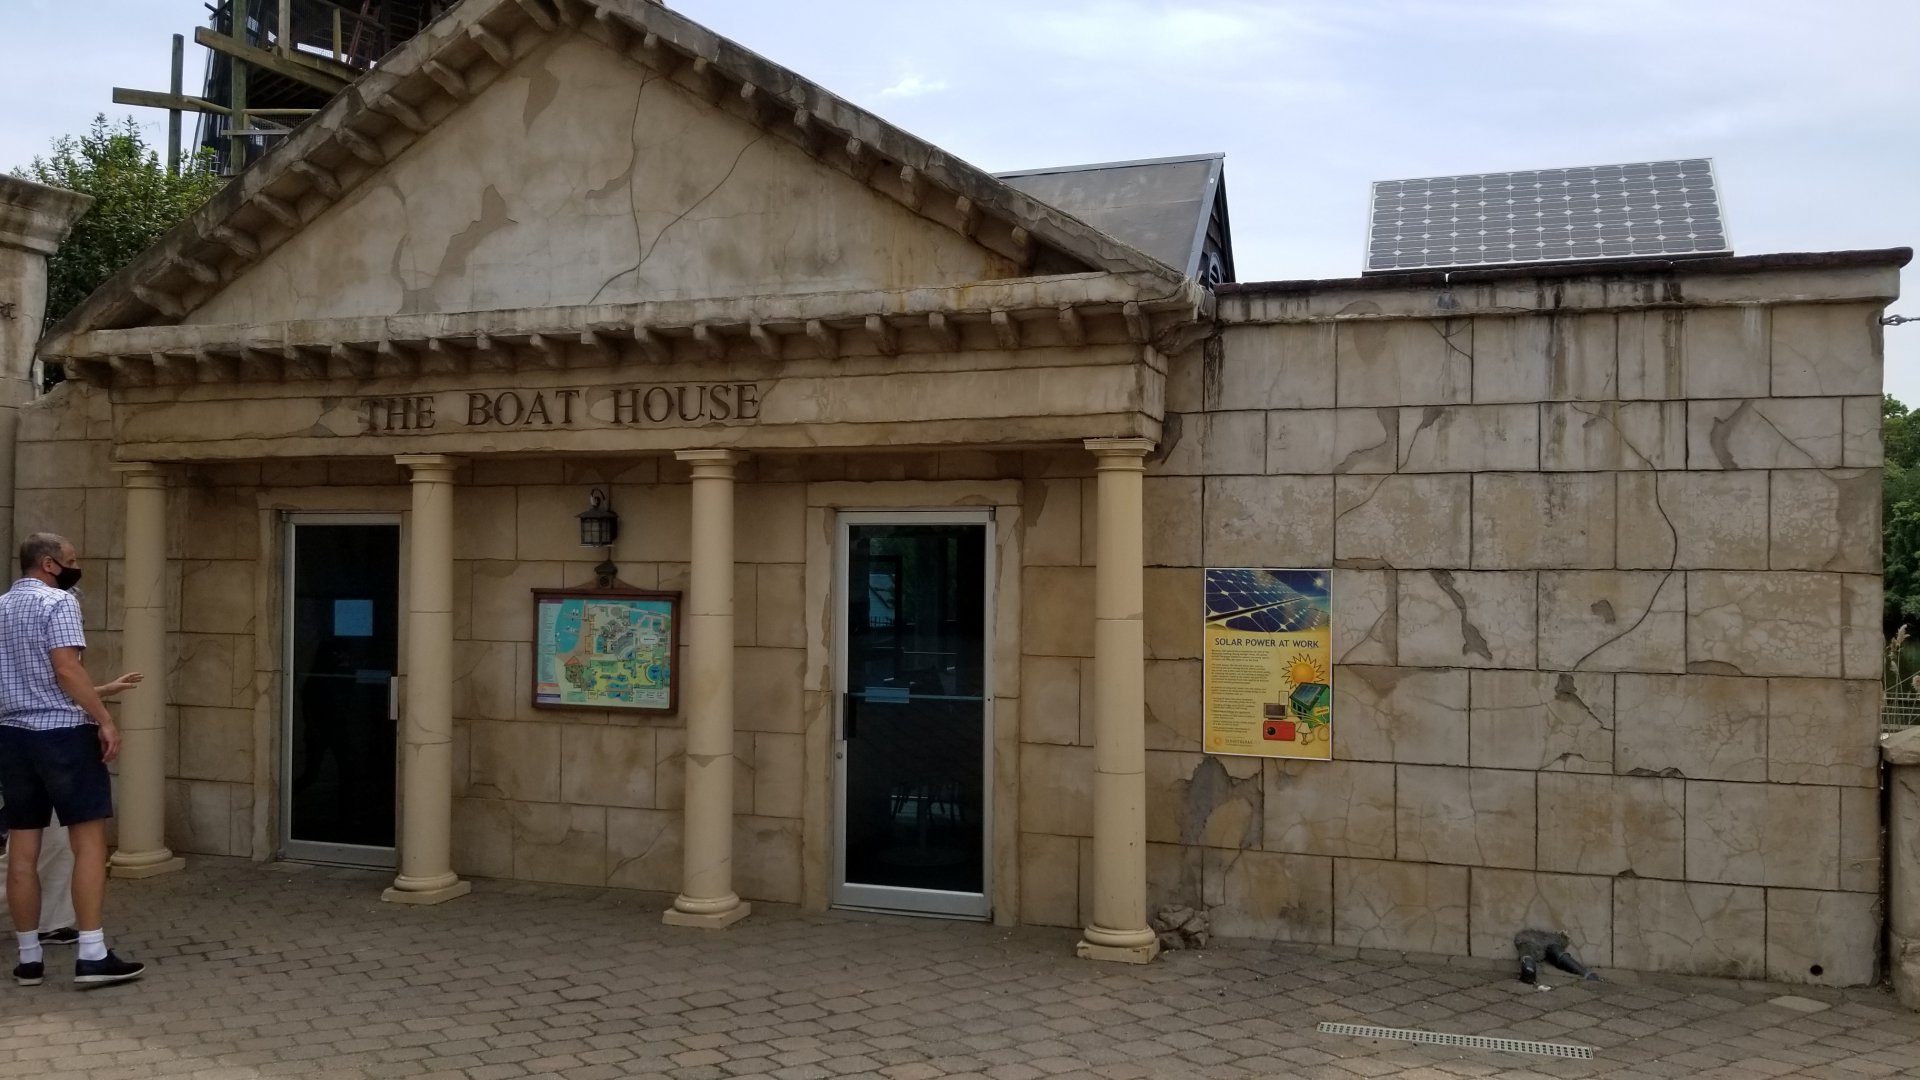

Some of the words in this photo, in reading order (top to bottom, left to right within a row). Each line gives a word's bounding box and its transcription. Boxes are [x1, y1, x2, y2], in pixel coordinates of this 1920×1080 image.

[361, 396, 435, 432] THE
[466, 389, 579, 426] BOAT
[611, 383, 760, 424] HOUSE
[1215, 638, 1242, 646] SOLAR
[1245, 638, 1276, 647] POWER
[1279, 639, 1289, 647] AT
[1293, 640, 1319, 648] WORK
